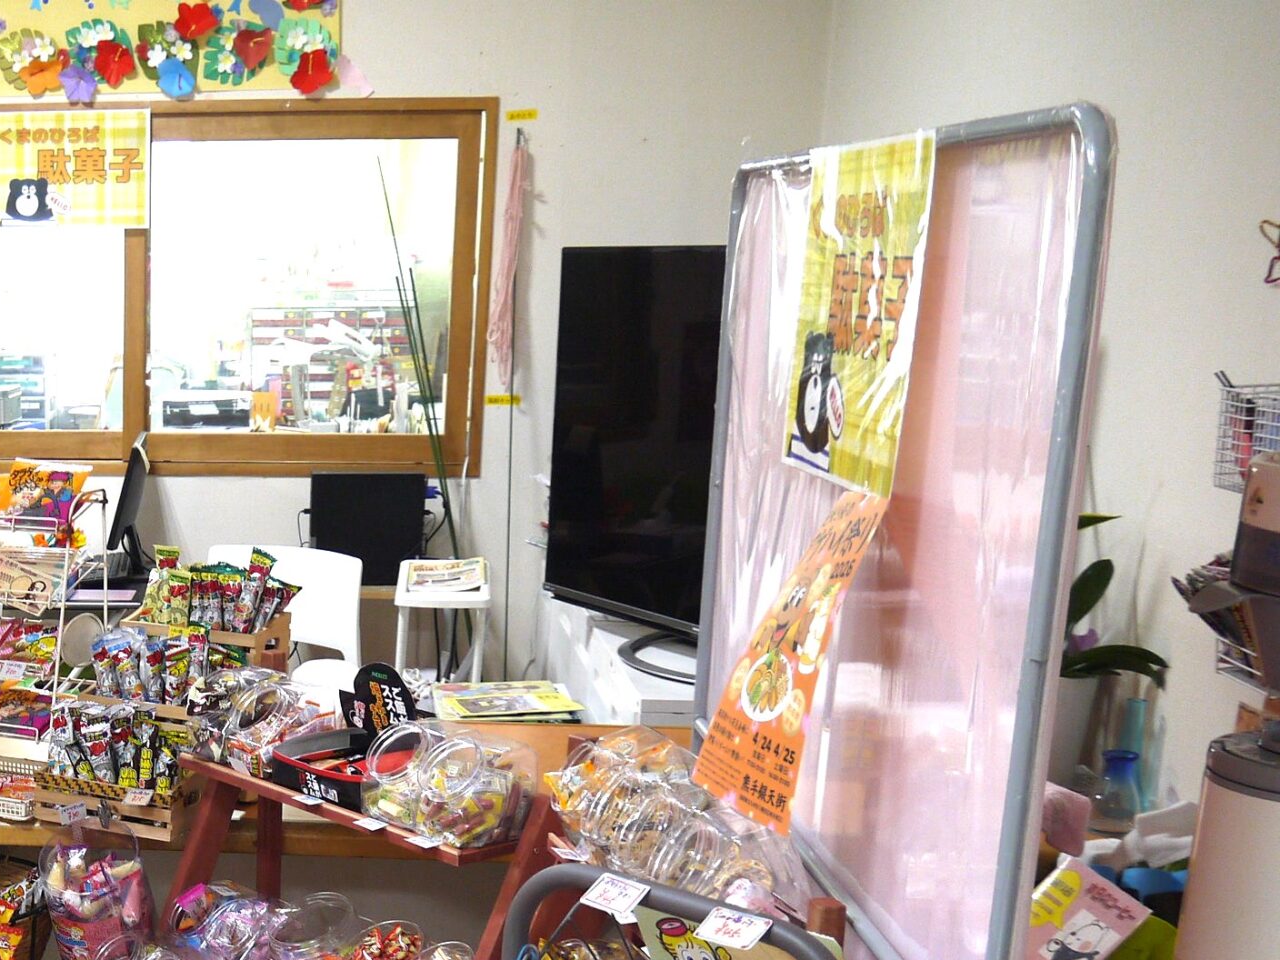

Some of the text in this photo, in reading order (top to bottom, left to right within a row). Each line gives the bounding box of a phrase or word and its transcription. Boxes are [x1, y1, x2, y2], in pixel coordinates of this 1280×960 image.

[0, 126, 101, 145] くまのひろば
[37, 147, 144, 185] 駄菓子
